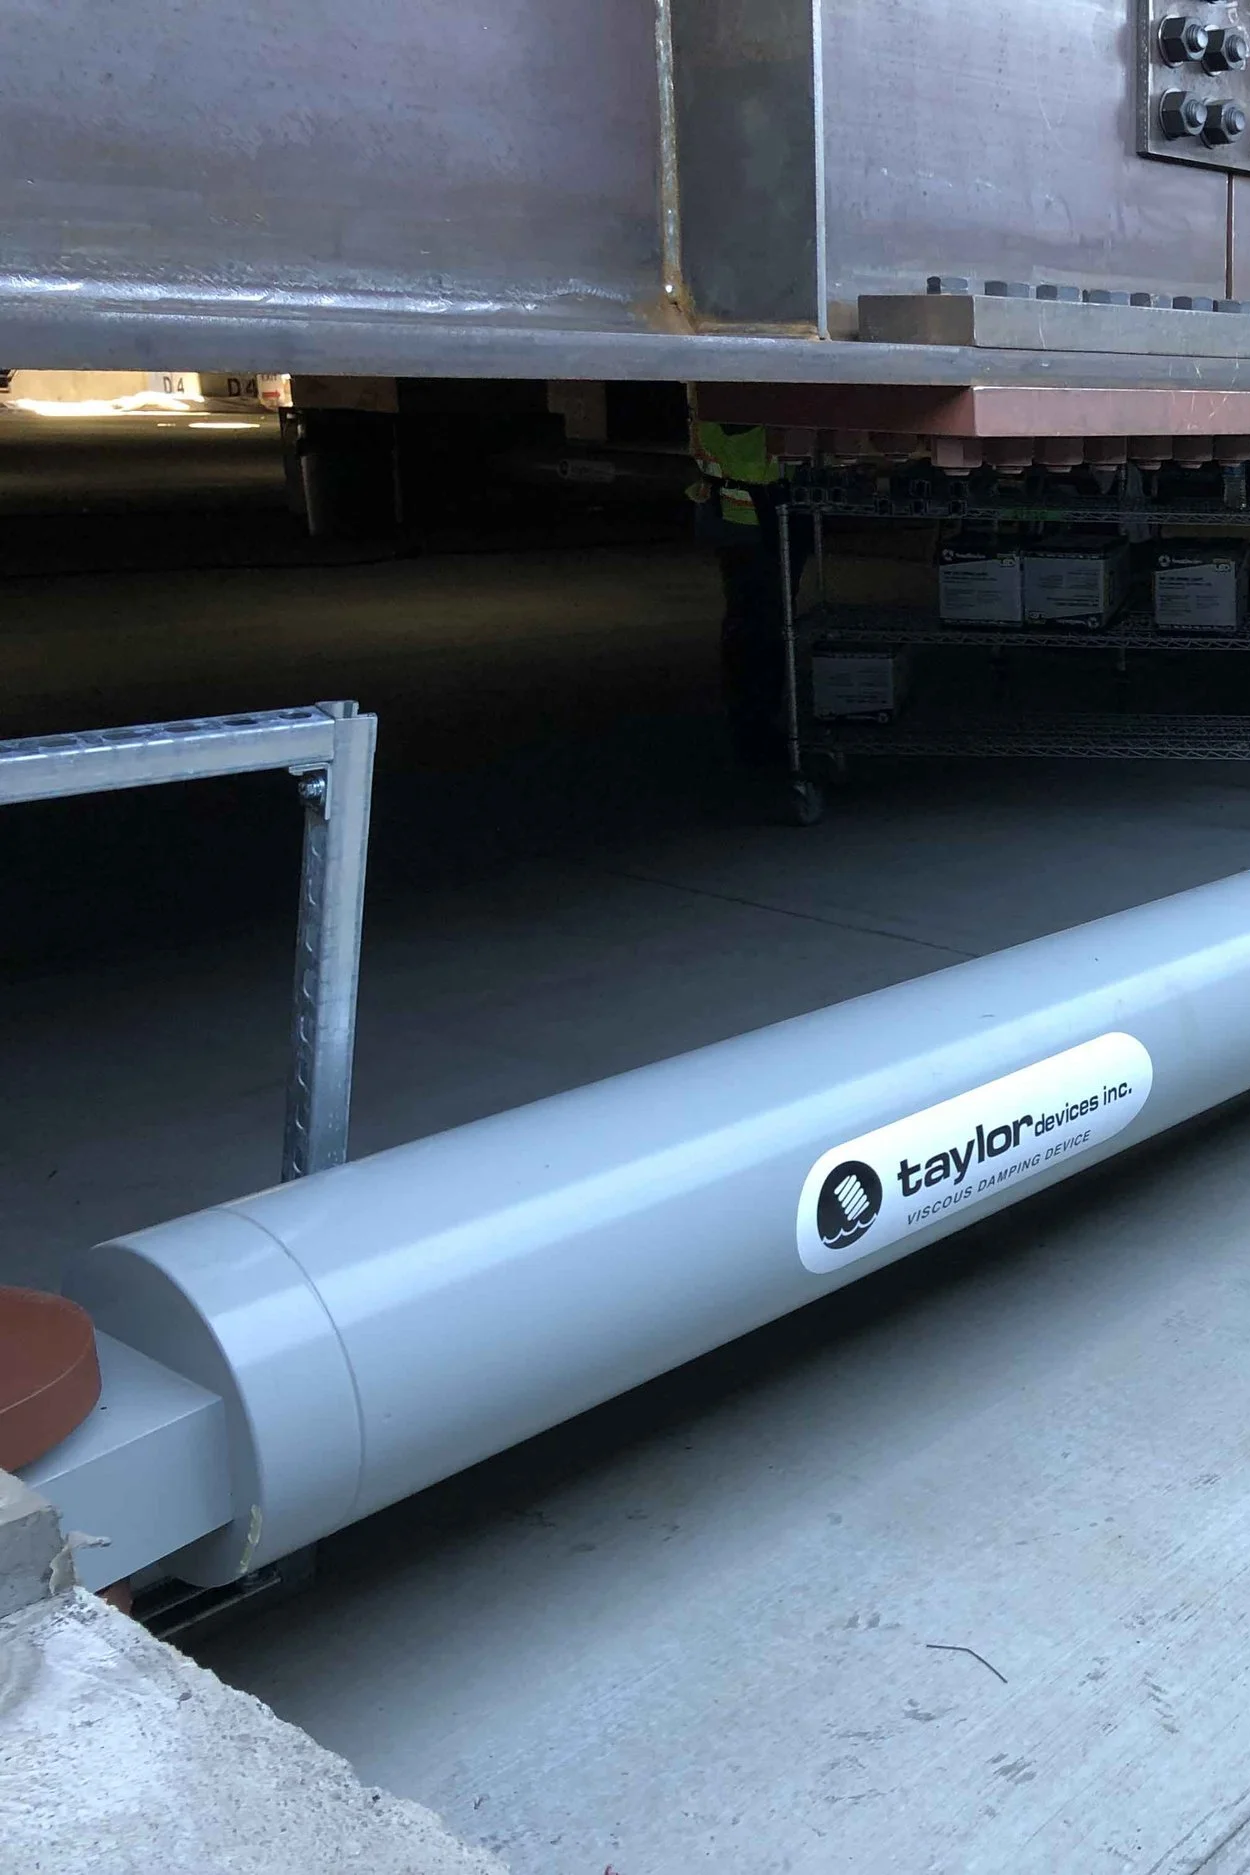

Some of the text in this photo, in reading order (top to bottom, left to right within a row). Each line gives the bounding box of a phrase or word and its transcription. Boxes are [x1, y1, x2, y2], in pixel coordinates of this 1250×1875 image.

[897, 1082, 1132, 1198] taylor devices inc.
[907, 1129, 1091, 1225] VISCOUS DAMPING DEVICE
